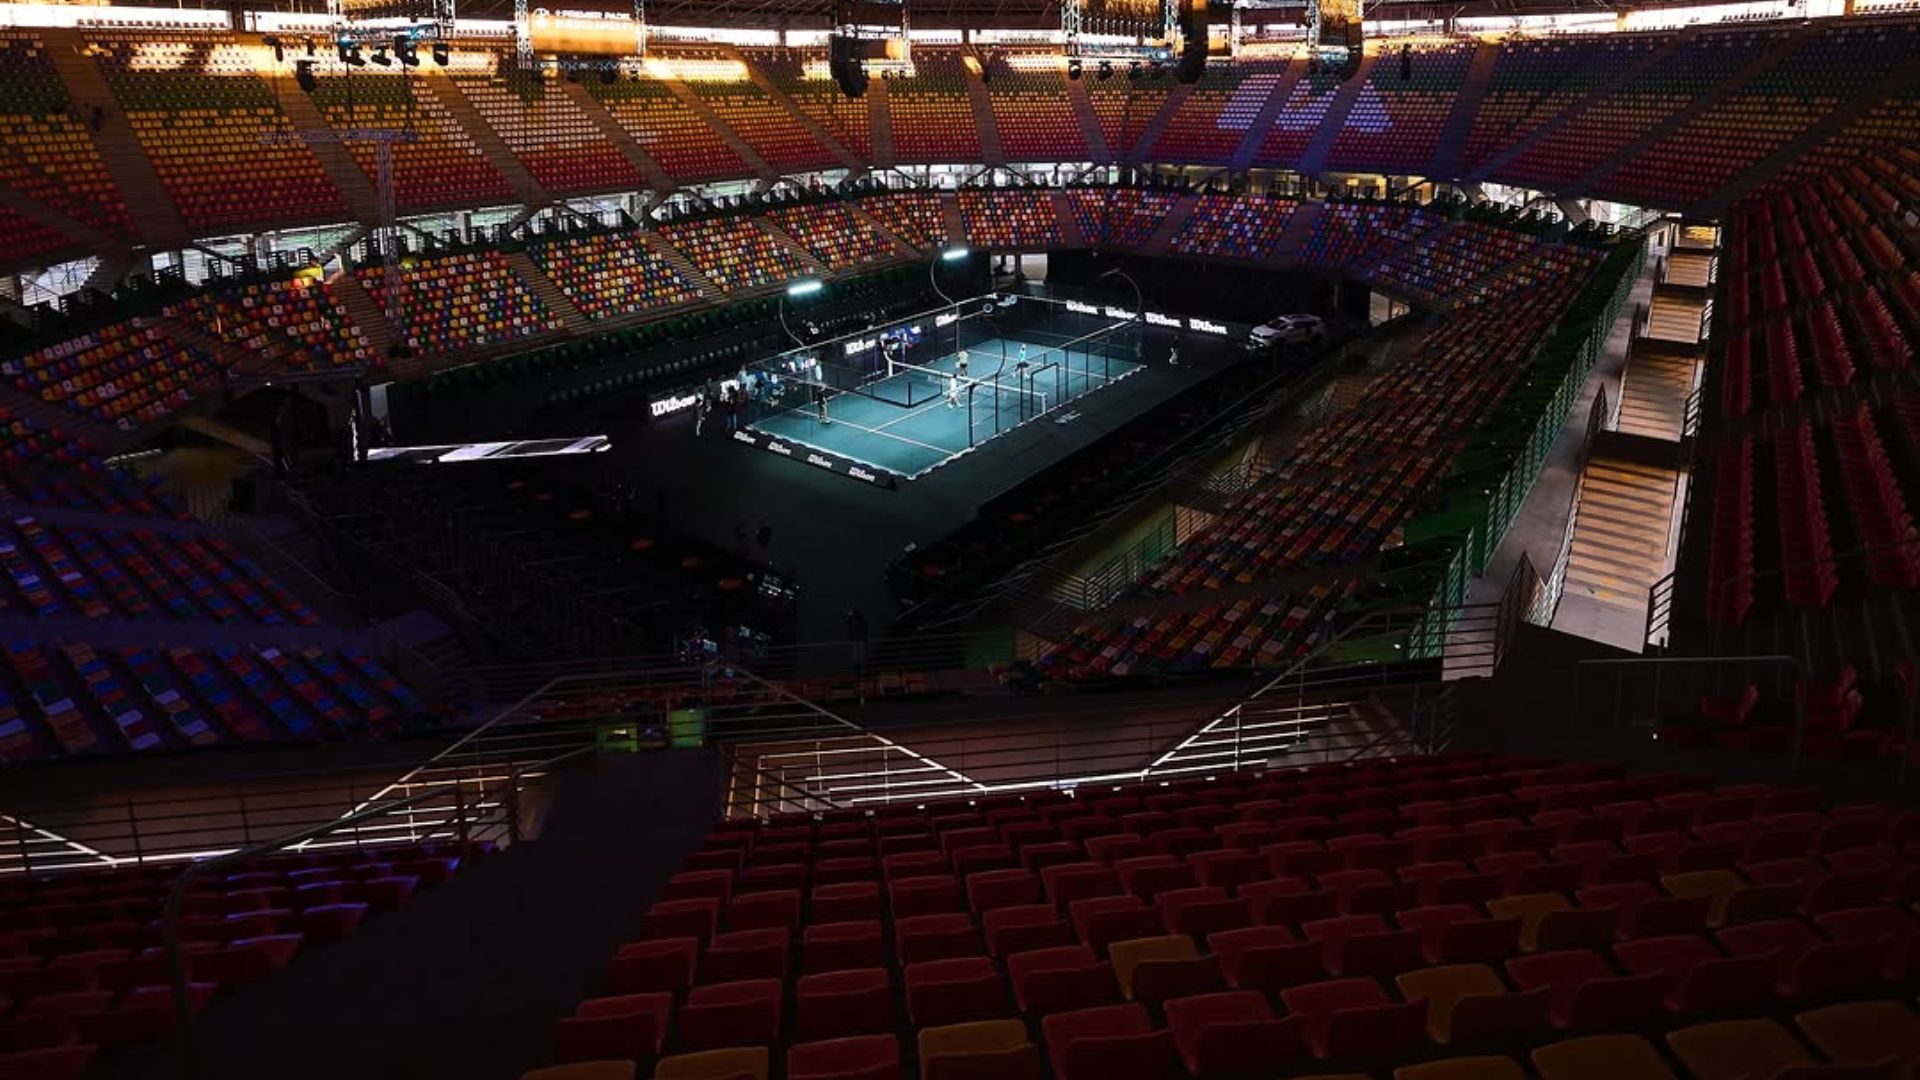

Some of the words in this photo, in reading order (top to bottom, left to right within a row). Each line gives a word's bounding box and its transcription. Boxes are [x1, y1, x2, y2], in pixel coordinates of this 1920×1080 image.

[1066, 299, 1098, 314] Wilson
[1145, 311, 1182, 328] Wilson
[1189, 317, 1228, 335] Wilson
[650, 394, 696, 416] Wilson
[768, 441, 792, 455] Wilson
[807, 453, 832, 469] Wilson
[849, 466, 875, 482] Wilson
